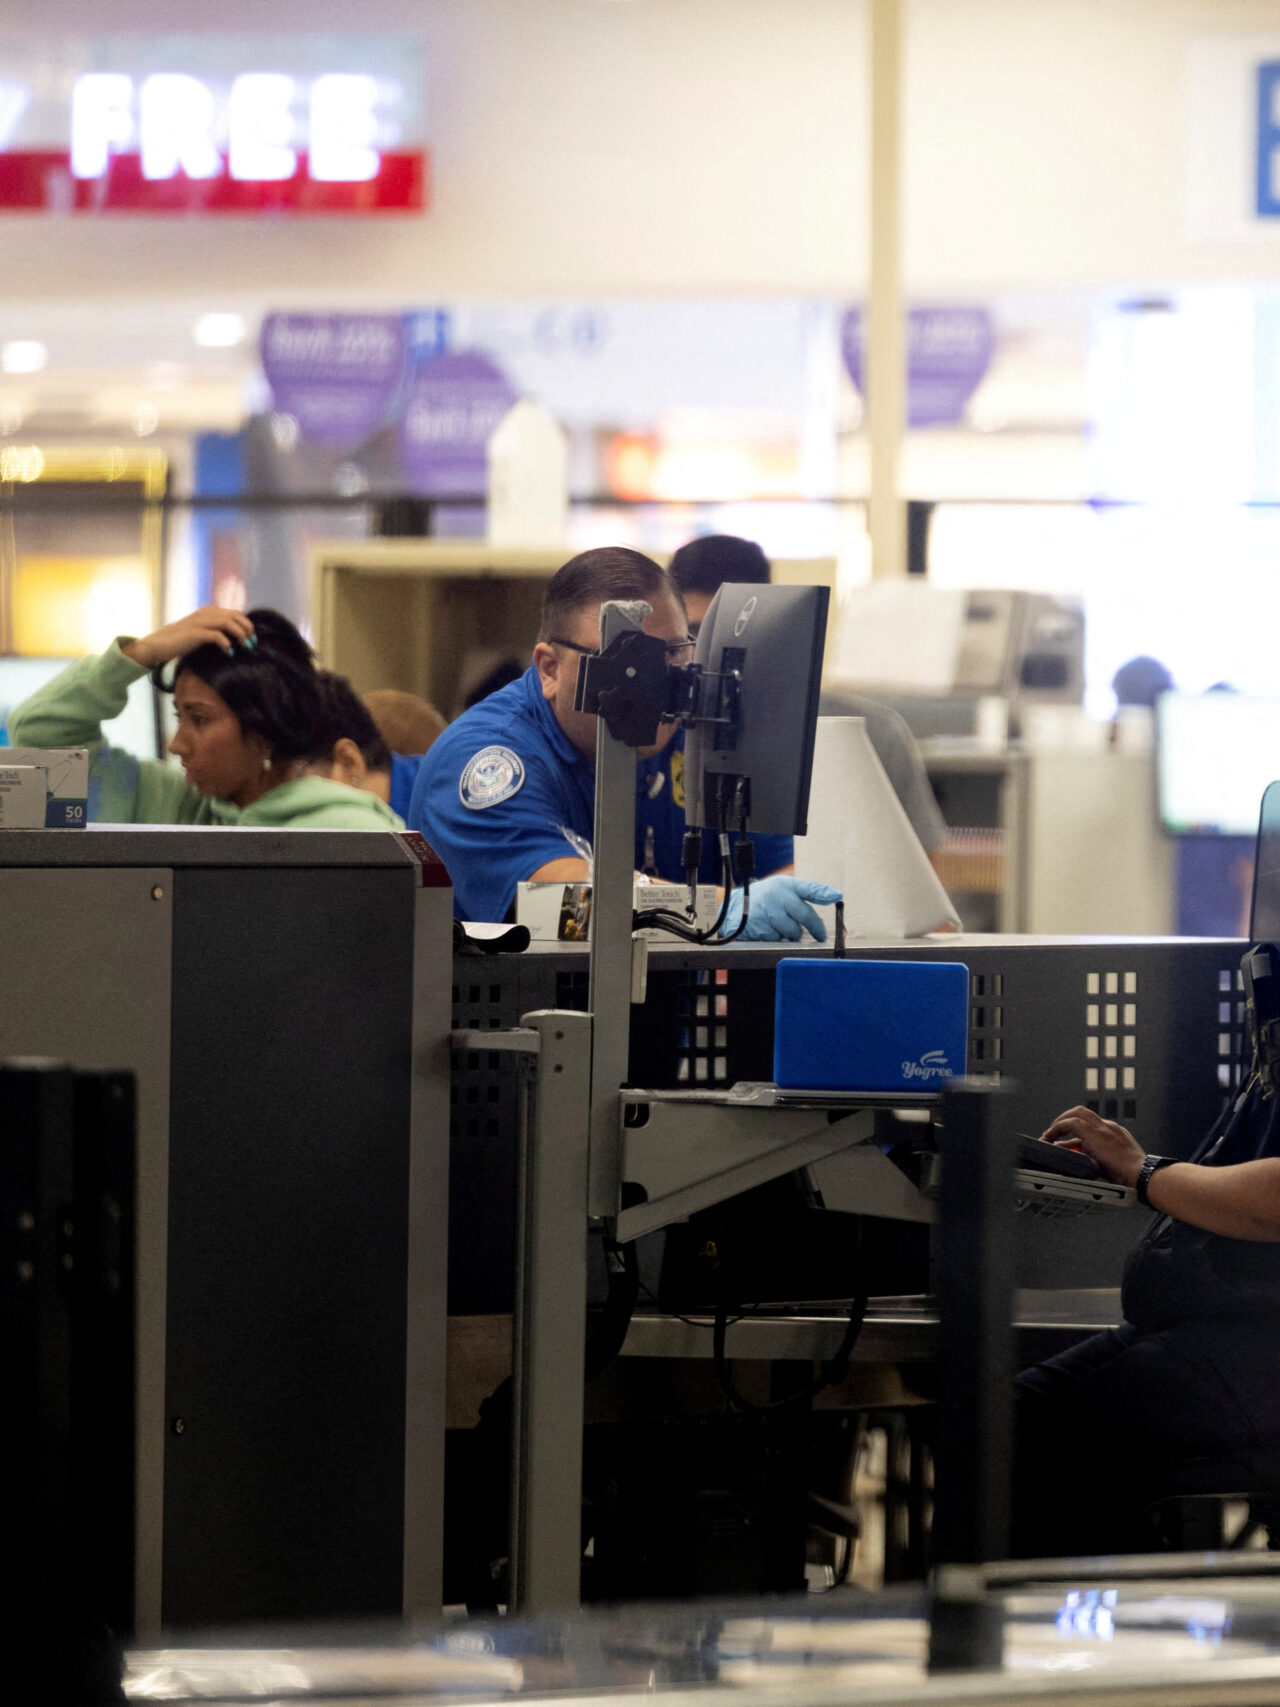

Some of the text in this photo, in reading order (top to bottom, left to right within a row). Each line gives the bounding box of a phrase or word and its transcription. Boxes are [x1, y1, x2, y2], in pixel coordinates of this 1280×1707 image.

[72, 72, 384, 182] FREE
[65, 806, 83, 818] 50
[901, 1061, 953, 1080] Yogree
